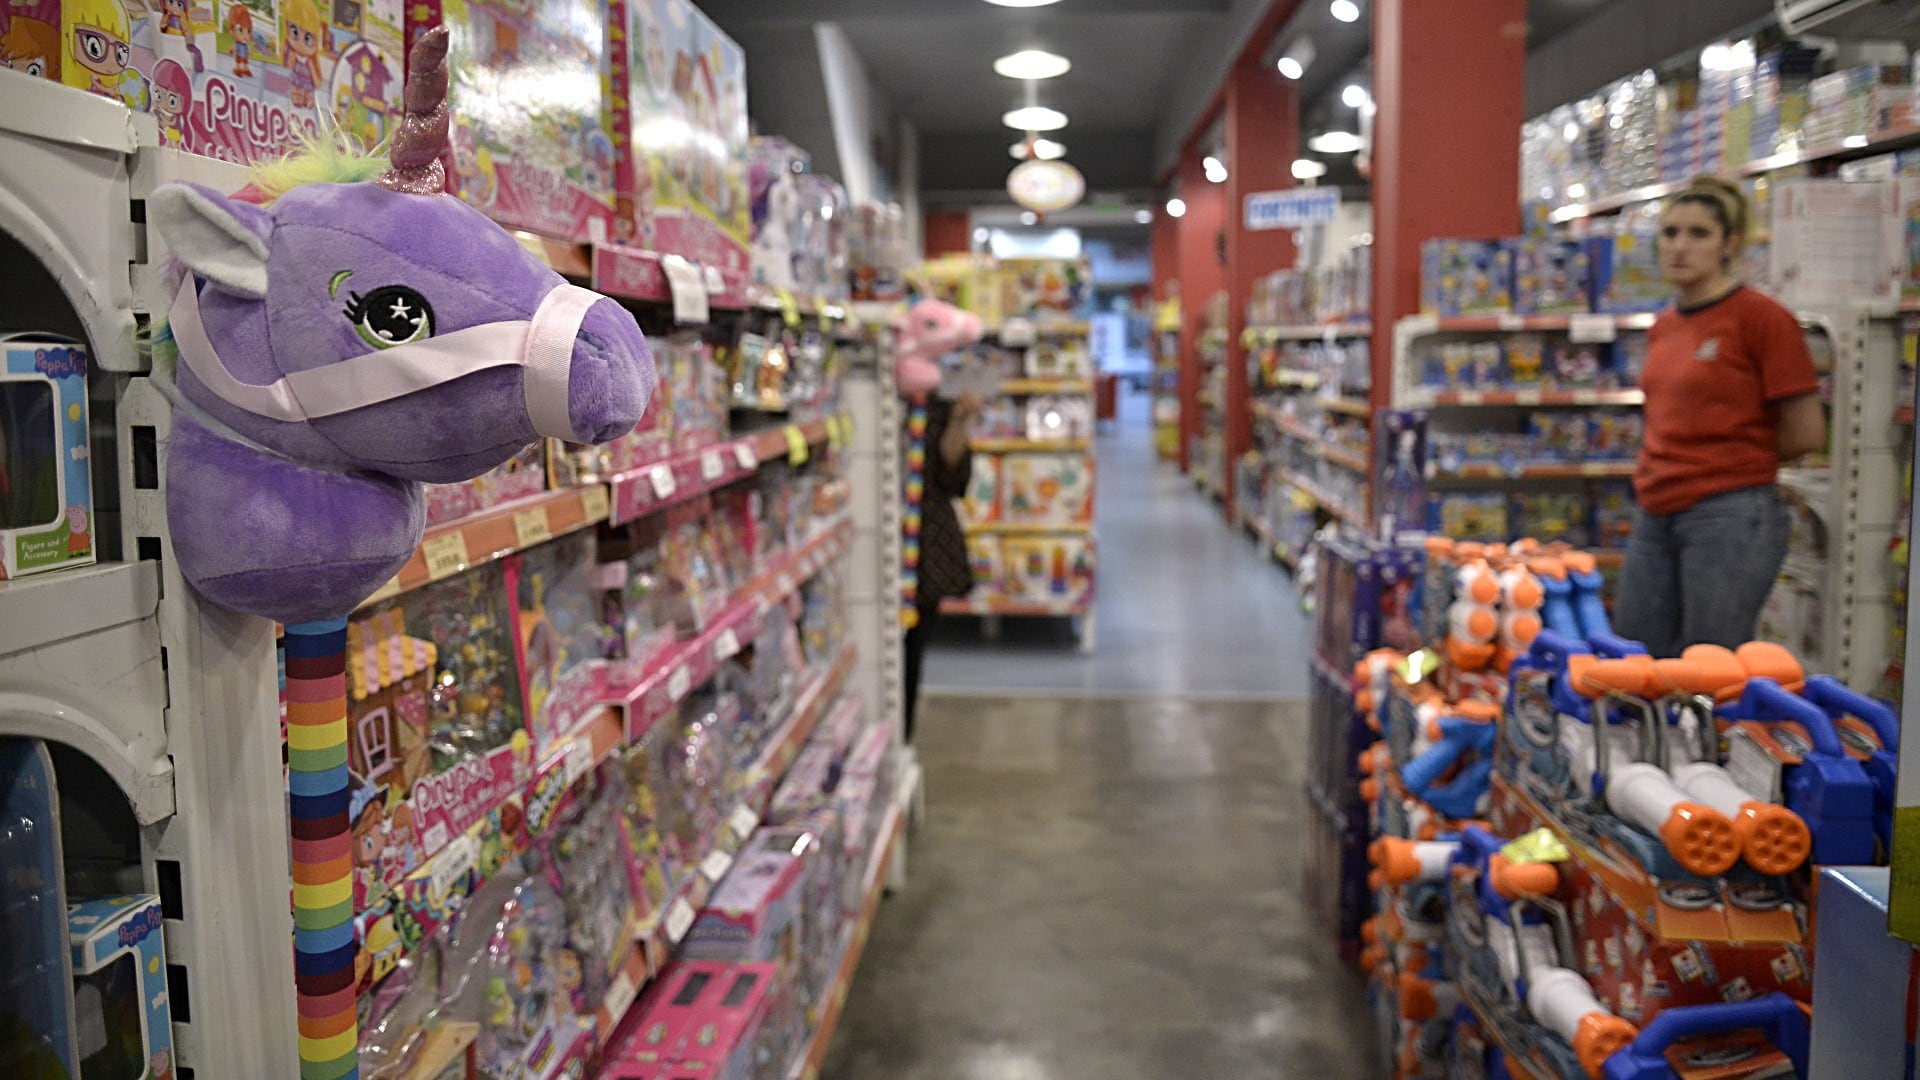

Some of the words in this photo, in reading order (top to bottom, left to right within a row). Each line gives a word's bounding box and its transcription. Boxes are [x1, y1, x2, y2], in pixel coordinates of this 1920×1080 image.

[36, 350, 69, 374] Peppa
[22, 541, 46, 552] Figure
[47, 538, 60, 548] and
[23, 550, 59, 560] Accessory
[119, 924, 149, 945] Peppa
[147, 908, 162, 930] Pig
